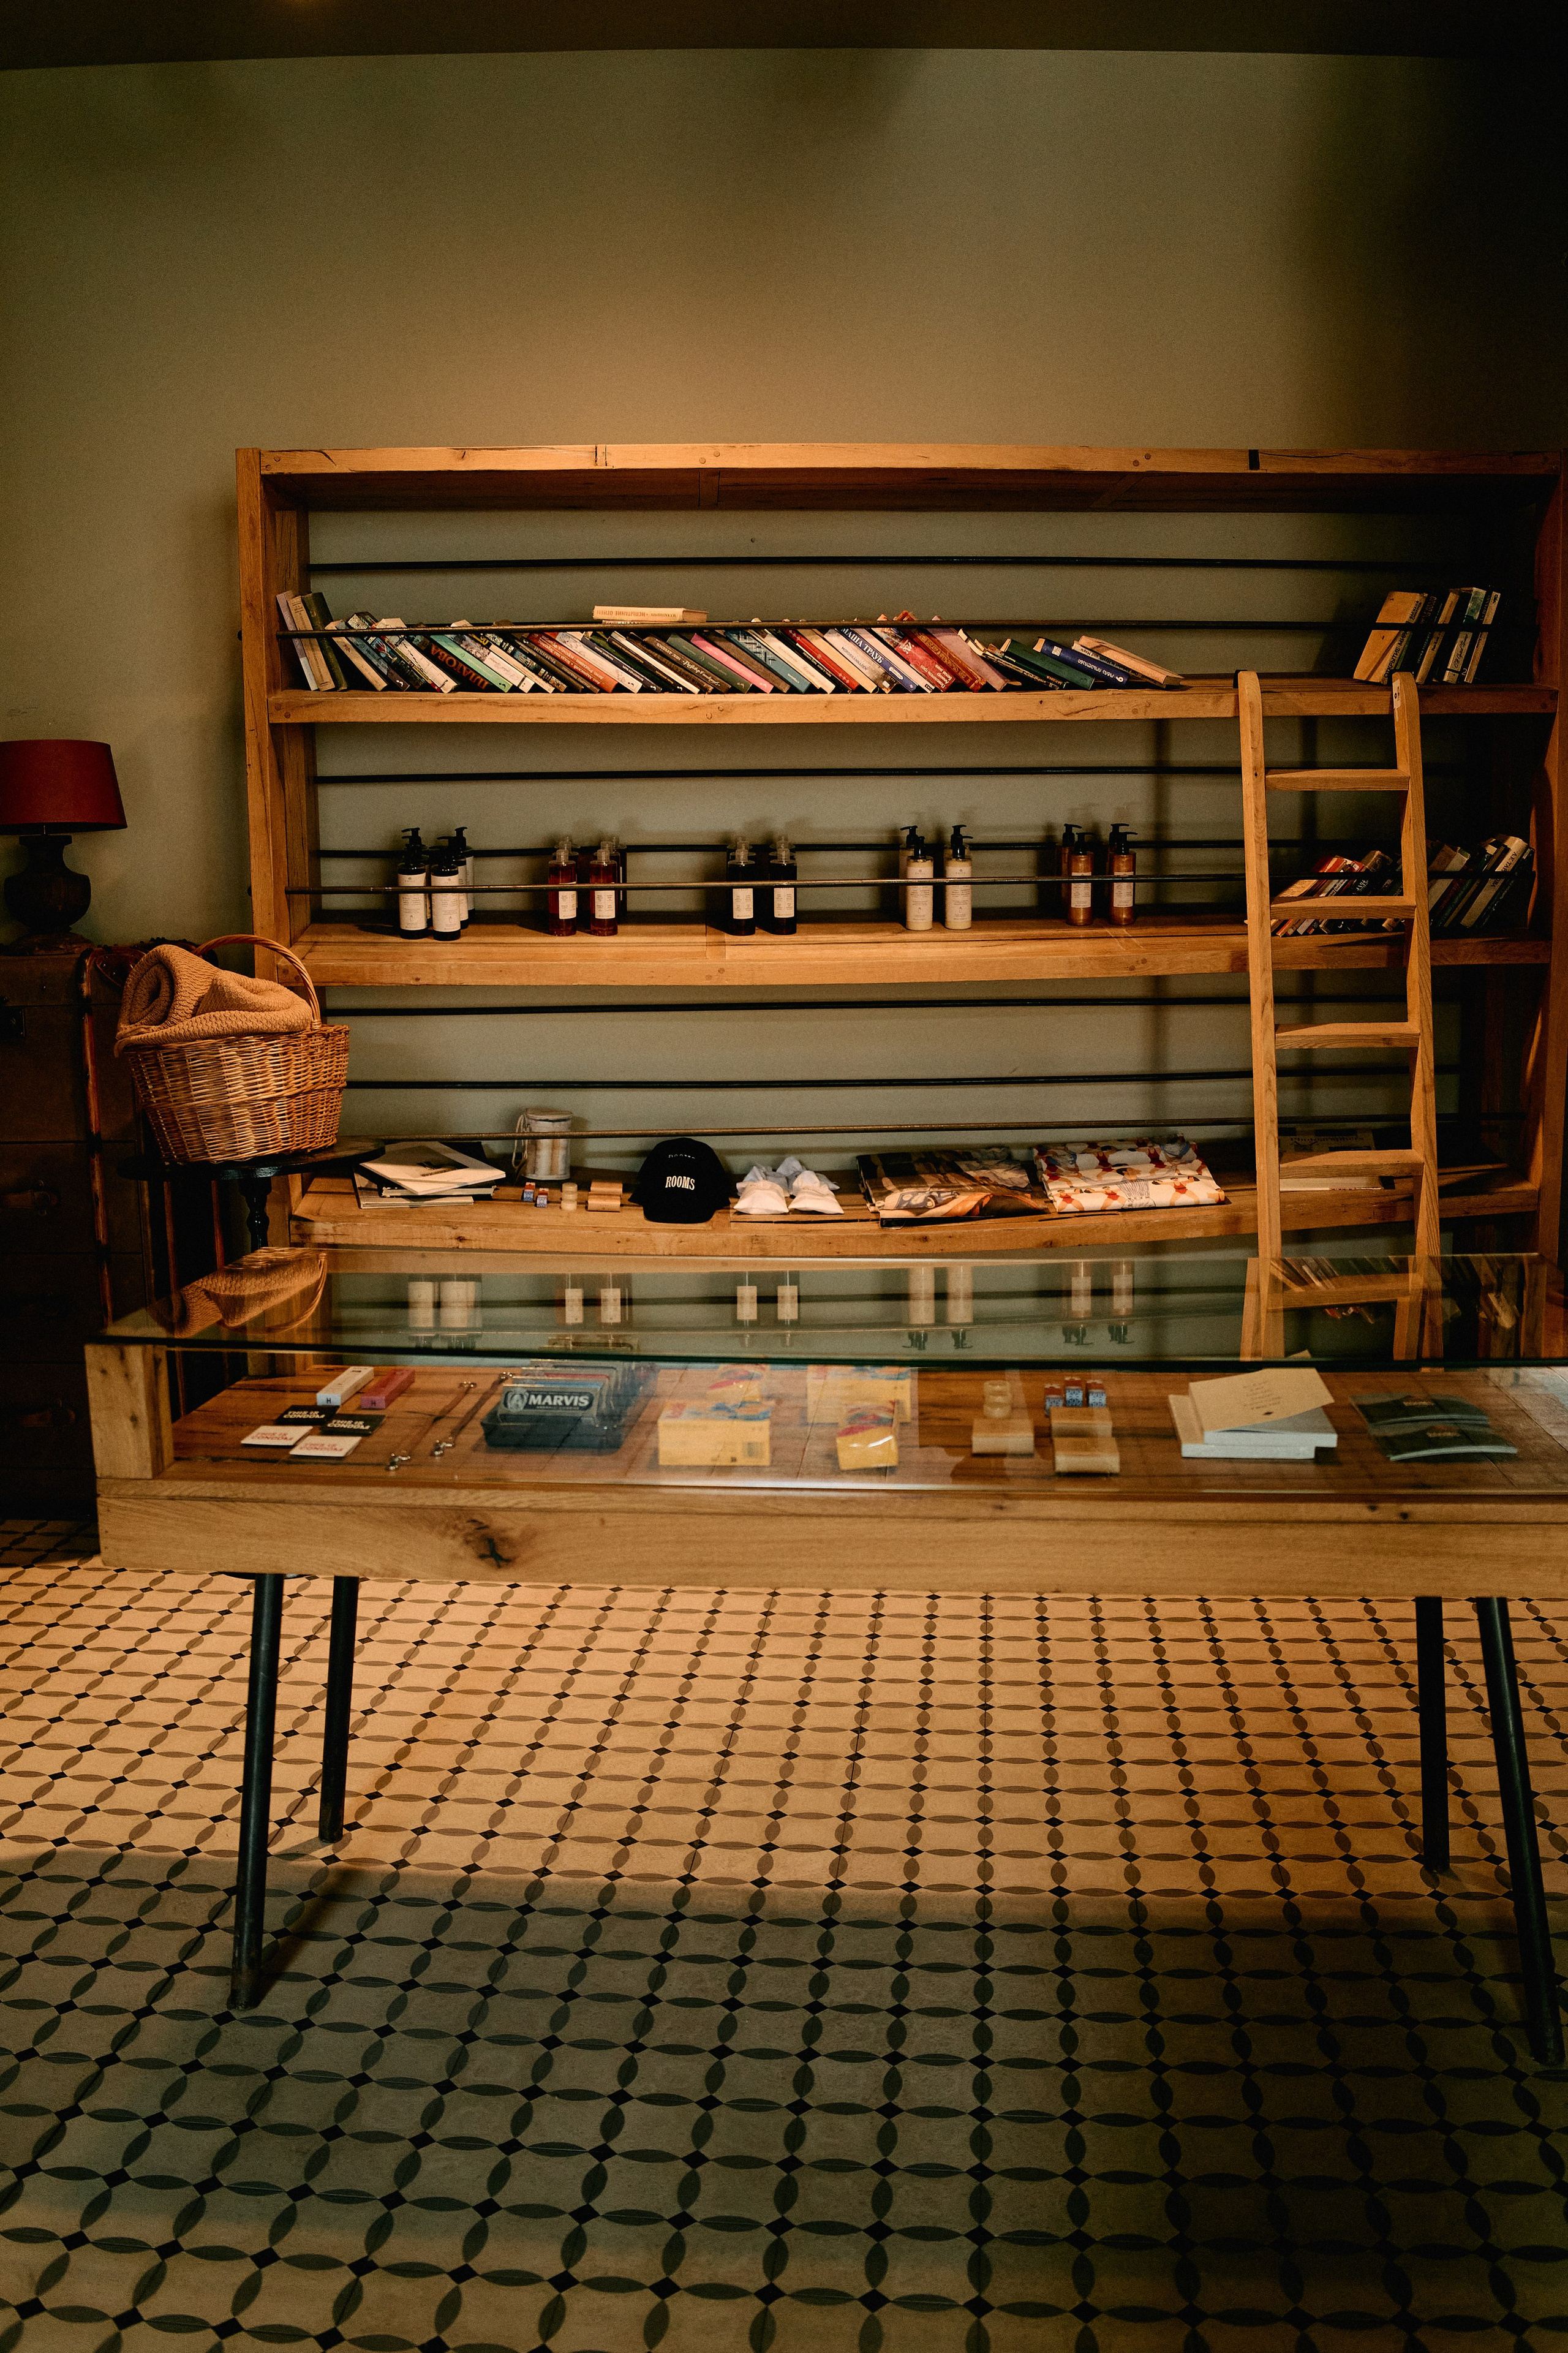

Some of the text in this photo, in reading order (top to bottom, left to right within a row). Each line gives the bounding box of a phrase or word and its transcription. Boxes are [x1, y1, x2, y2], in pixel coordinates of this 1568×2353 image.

[840, 625, 864, 648] МАША
[861, 643, 884, 664] ТРАУБ
[431, 644, 489, 690] ПЛАТОВА
[1382, 647, 1402, 678] ОТКРЫТИЕ
[665, 1176, 695, 1190] ROOMS
[529, 1394, 589, 1407] MARVIS
[327, 1422, 370, 1430] CONDOM
